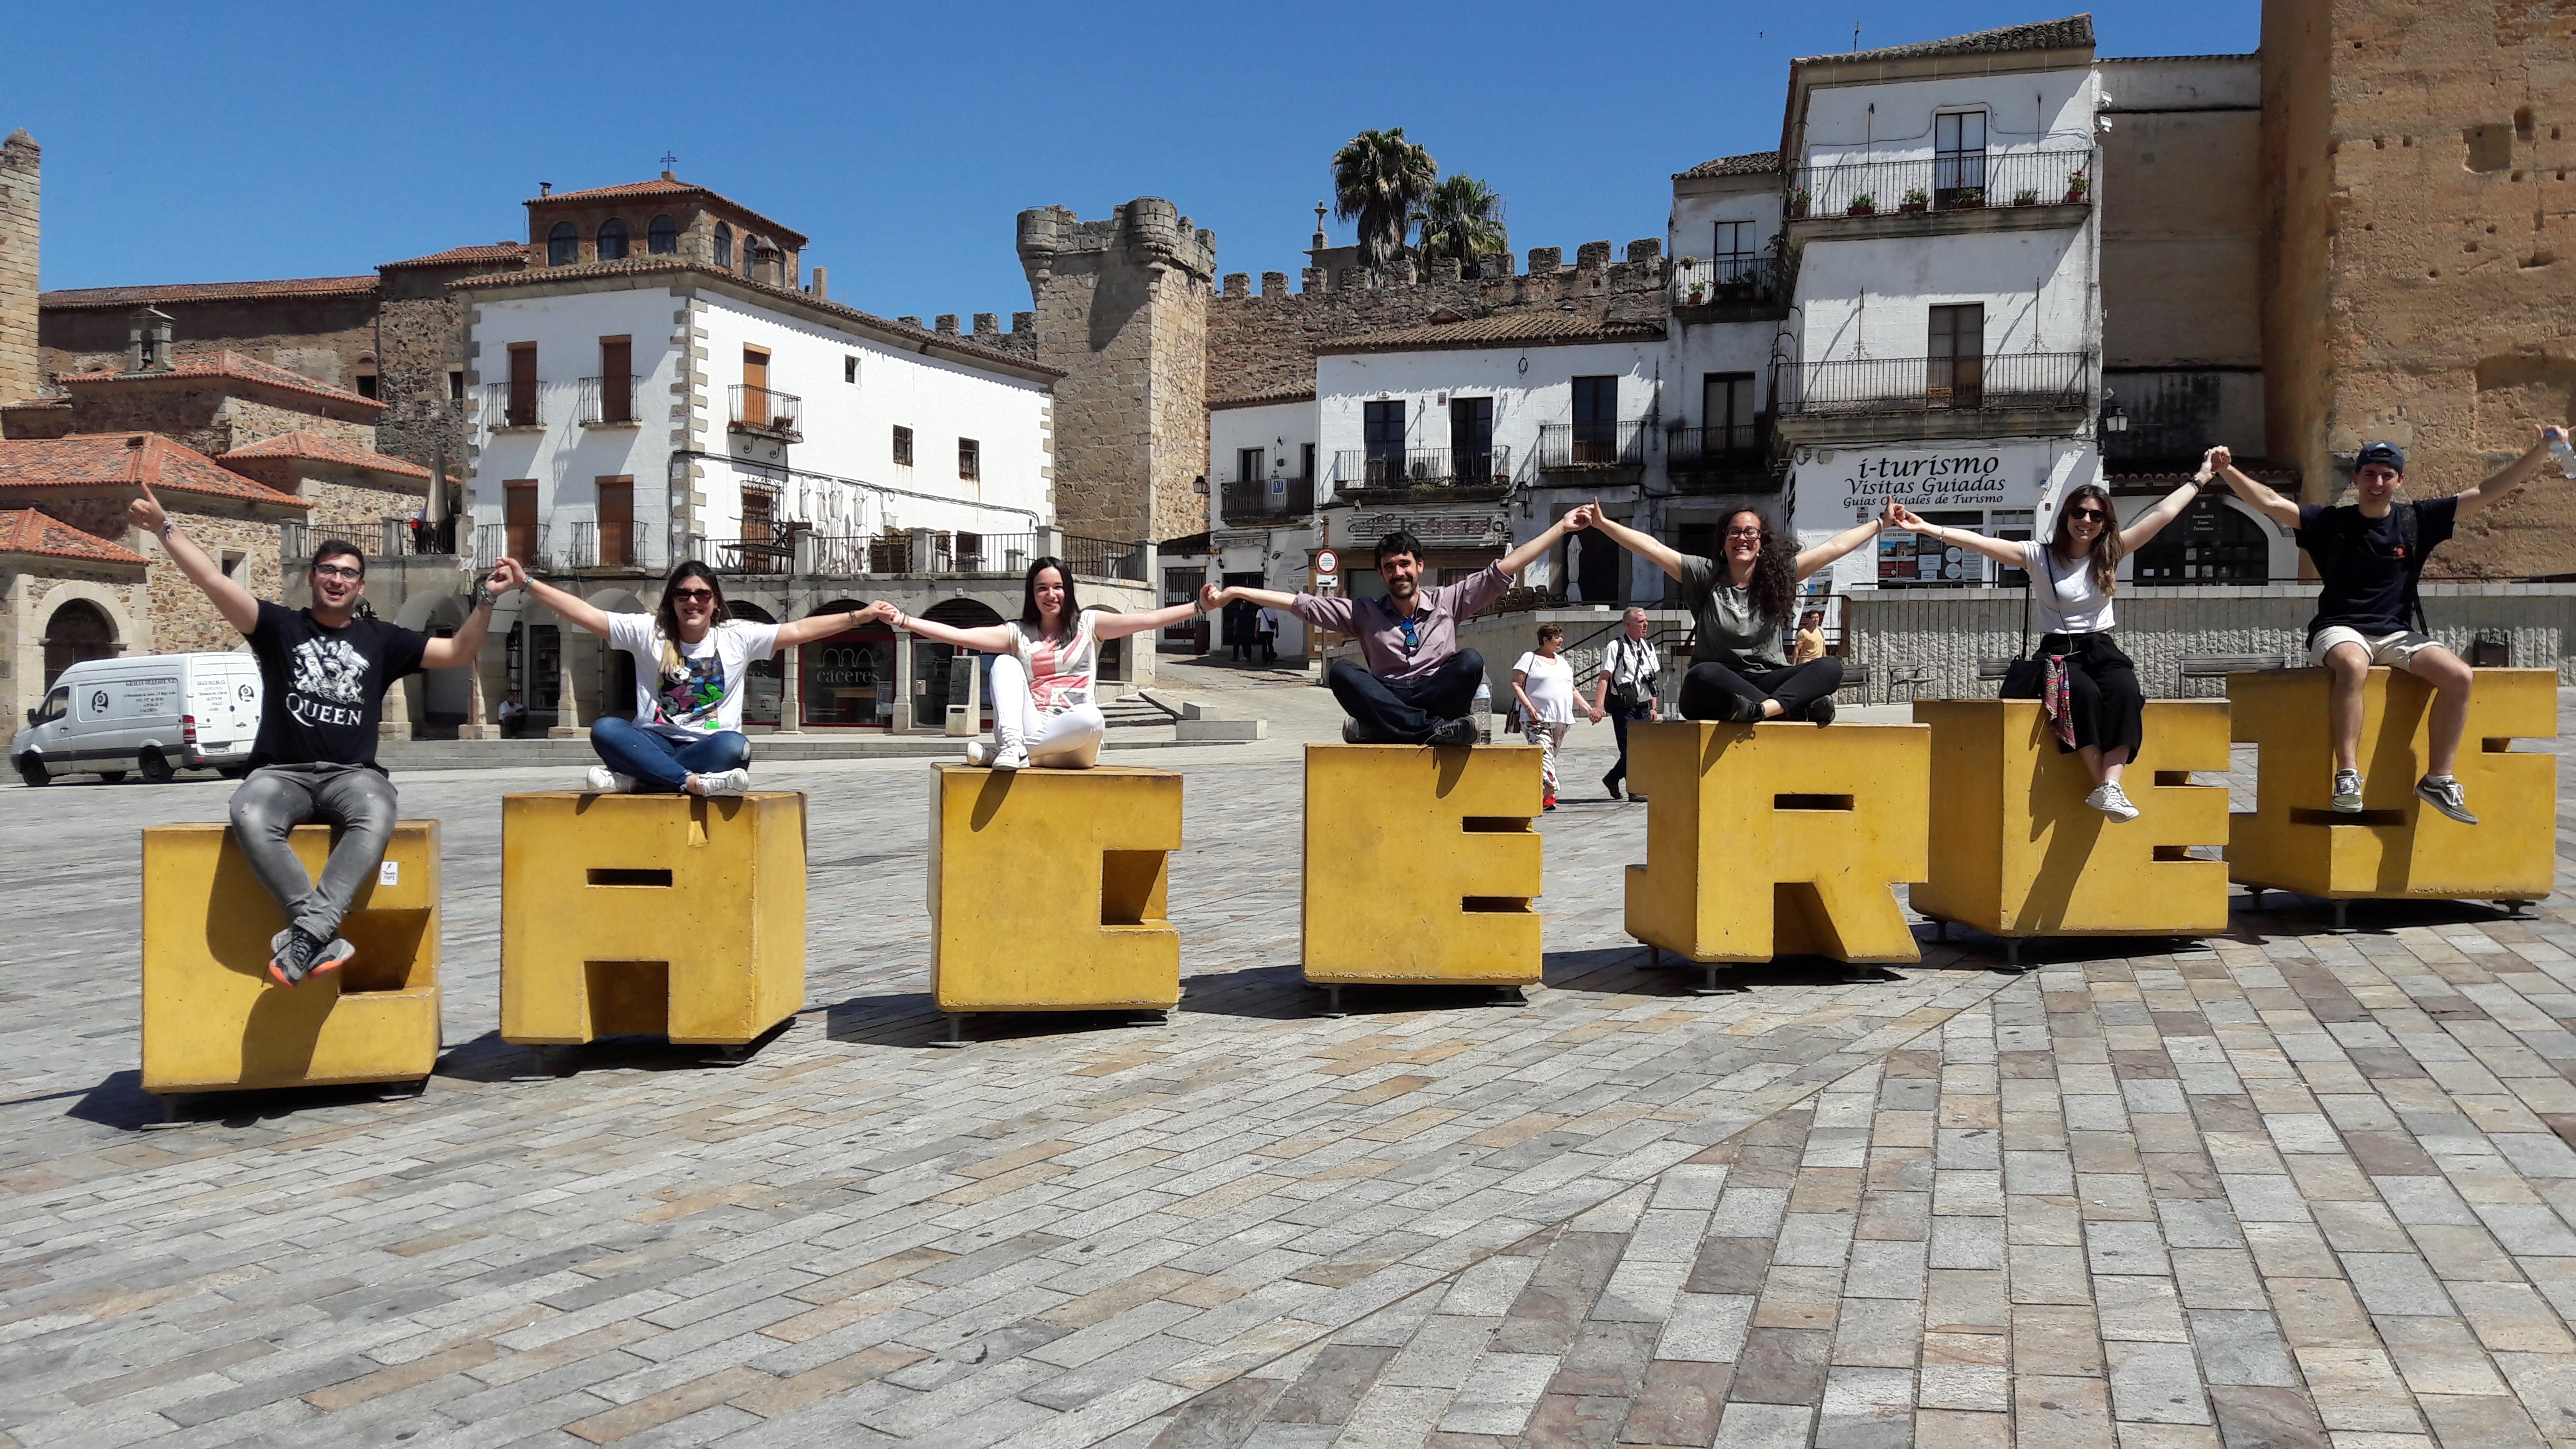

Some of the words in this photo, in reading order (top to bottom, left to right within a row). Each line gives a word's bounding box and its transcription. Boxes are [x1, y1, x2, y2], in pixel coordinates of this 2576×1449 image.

[1858, 454, 1999, 479] i-turismo
[1844, 477, 1915, 495] Visitas
[1922, 474, 2006, 496] Guiadas
[1843, 497, 1876, 509] Guias
[1934, 494, 1949, 505] de
[1952, 493, 2004, 505] Turismo
[285, 692, 363, 727] QUEEN
